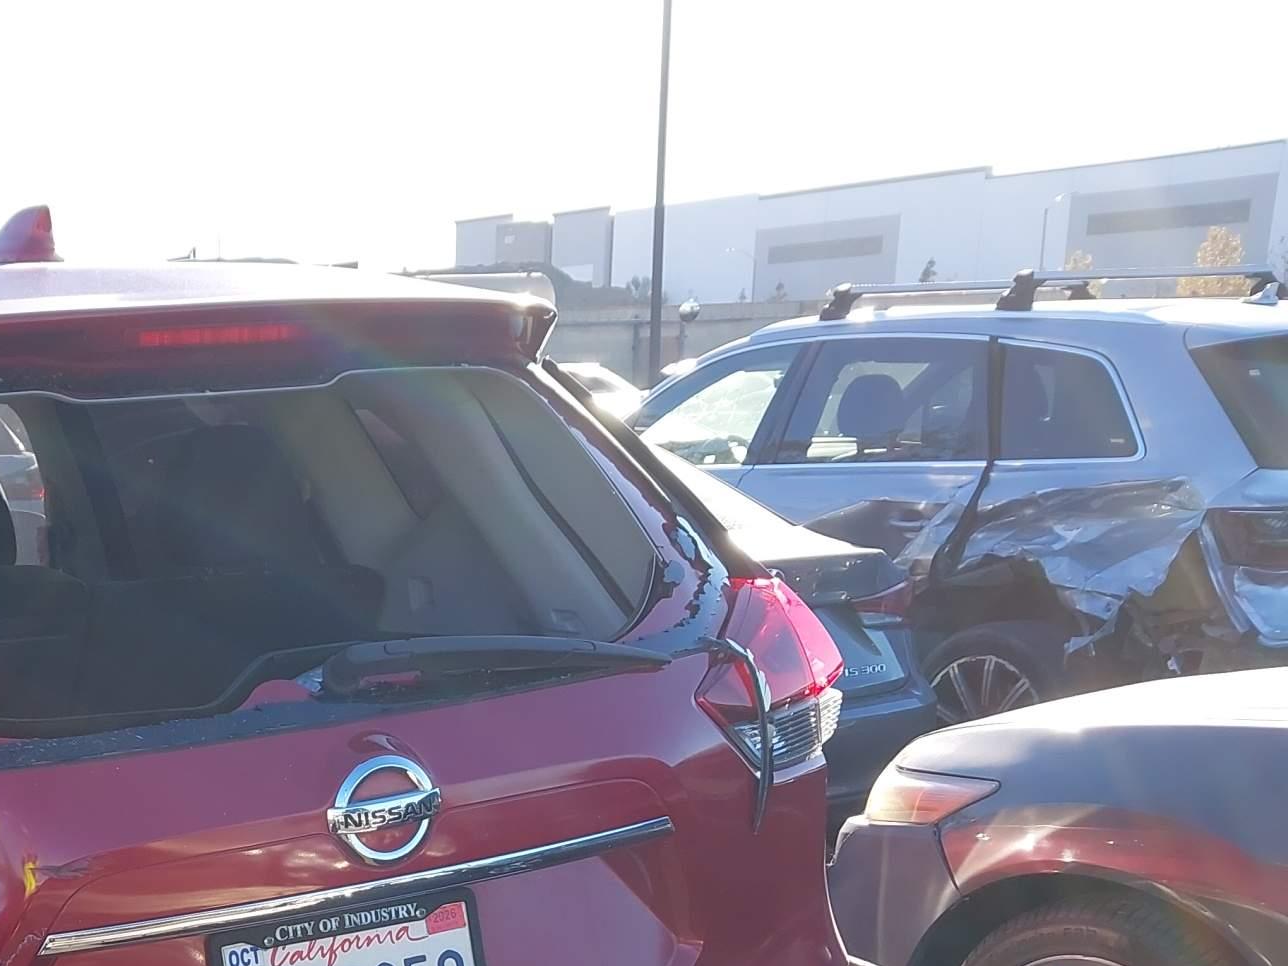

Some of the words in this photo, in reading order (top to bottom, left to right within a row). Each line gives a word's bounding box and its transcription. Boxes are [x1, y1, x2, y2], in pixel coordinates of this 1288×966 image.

[844, 667, 858, 677] IS
[862, 663, 886, 674] 300
[343, 796, 435, 828] NISSAN
[275, 923, 315, 942] CITY
[319, 916, 339, 933] OF
[344, 903, 418, 929] INDUSTRY
